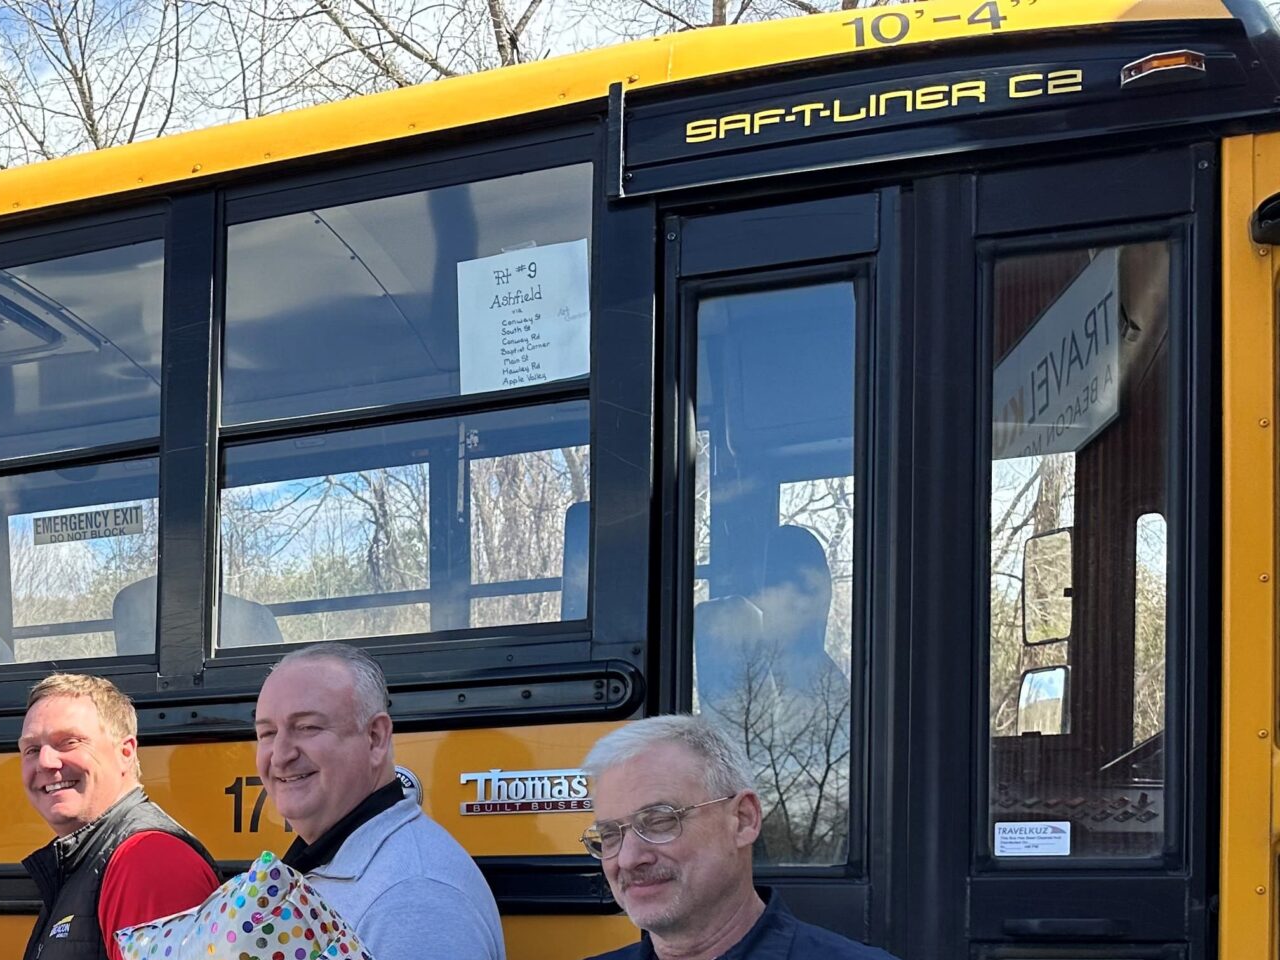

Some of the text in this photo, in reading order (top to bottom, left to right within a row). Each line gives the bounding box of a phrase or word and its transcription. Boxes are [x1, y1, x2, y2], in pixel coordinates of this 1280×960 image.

[686, 69, 1082, 143] SAF-T-LINER C2
[489, 284, 543, 309] Ashfield
[501, 317, 534, 327] Conway
[500, 327, 522, 336] South
[501, 333, 541, 346] Conway Rd
[526, 342, 551, 351] Corner
[503, 355, 529, 366] Main St
[502, 371, 547, 386] Apple Valley
[36, 506, 141, 535] EMERGENCY EXIT
[50, 527, 126, 543] DO NOT BLOCK
[460, 769, 592, 801] Thomas
[473, 800, 592, 813] BUILT BUSES
[998, 826, 1049, 834] TRAVELKUZ
